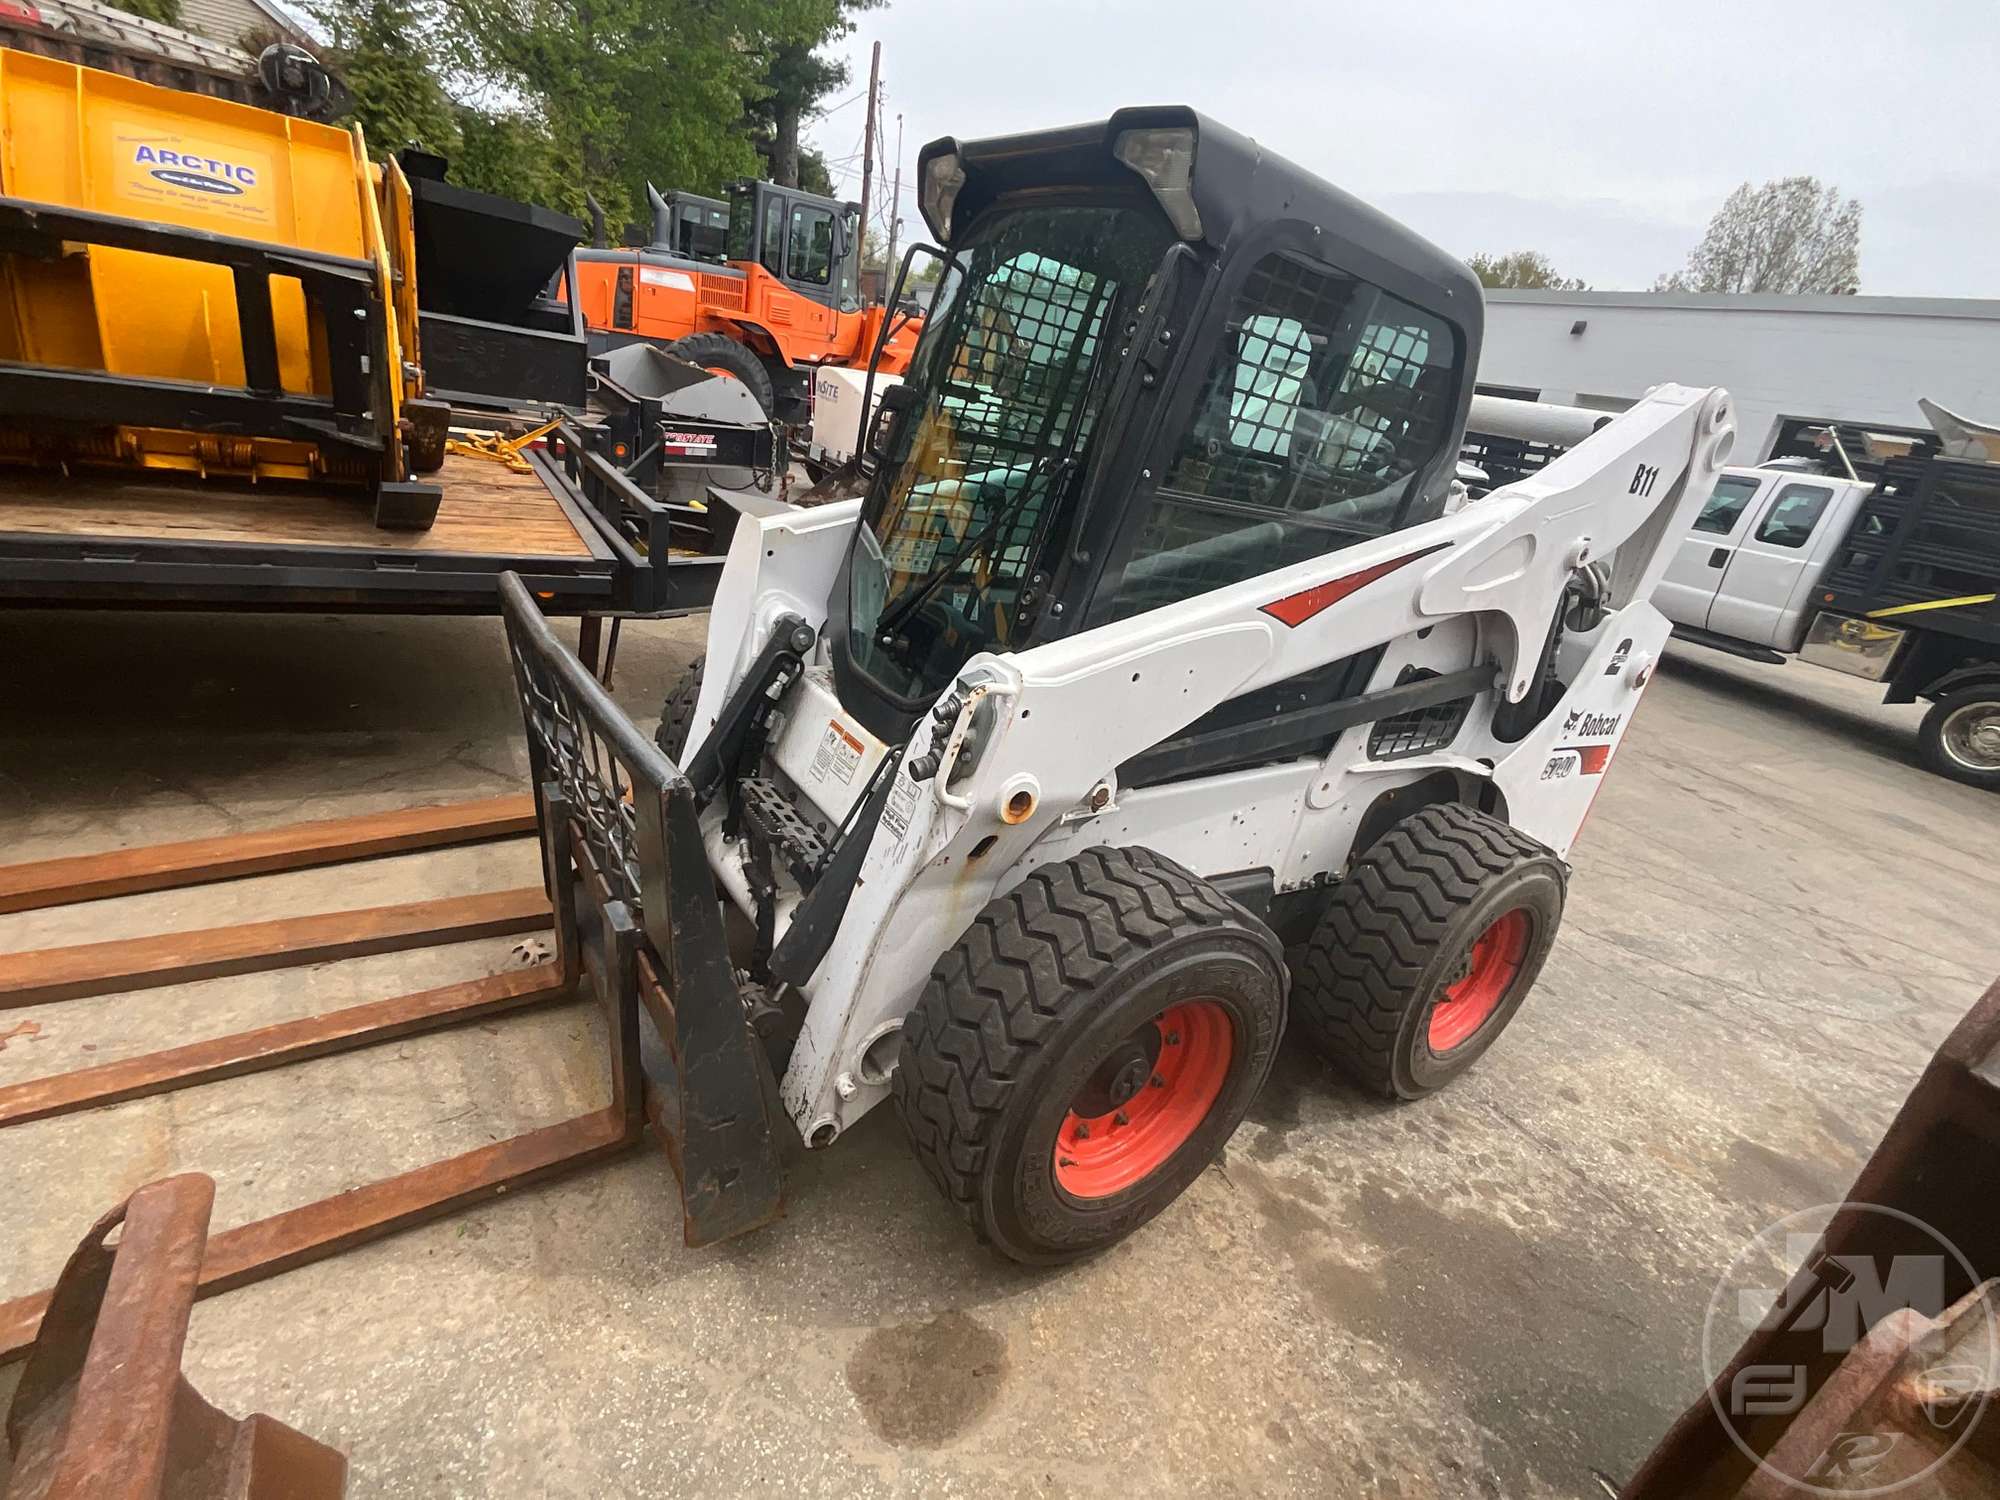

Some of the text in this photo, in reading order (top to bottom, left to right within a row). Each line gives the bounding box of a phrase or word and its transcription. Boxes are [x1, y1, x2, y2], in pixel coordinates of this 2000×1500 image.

[135, 145, 256, 185] ARCTIC
[1628, 463, 1660, 497] B11
[1578, 713, 1622, 737] Bobcat
